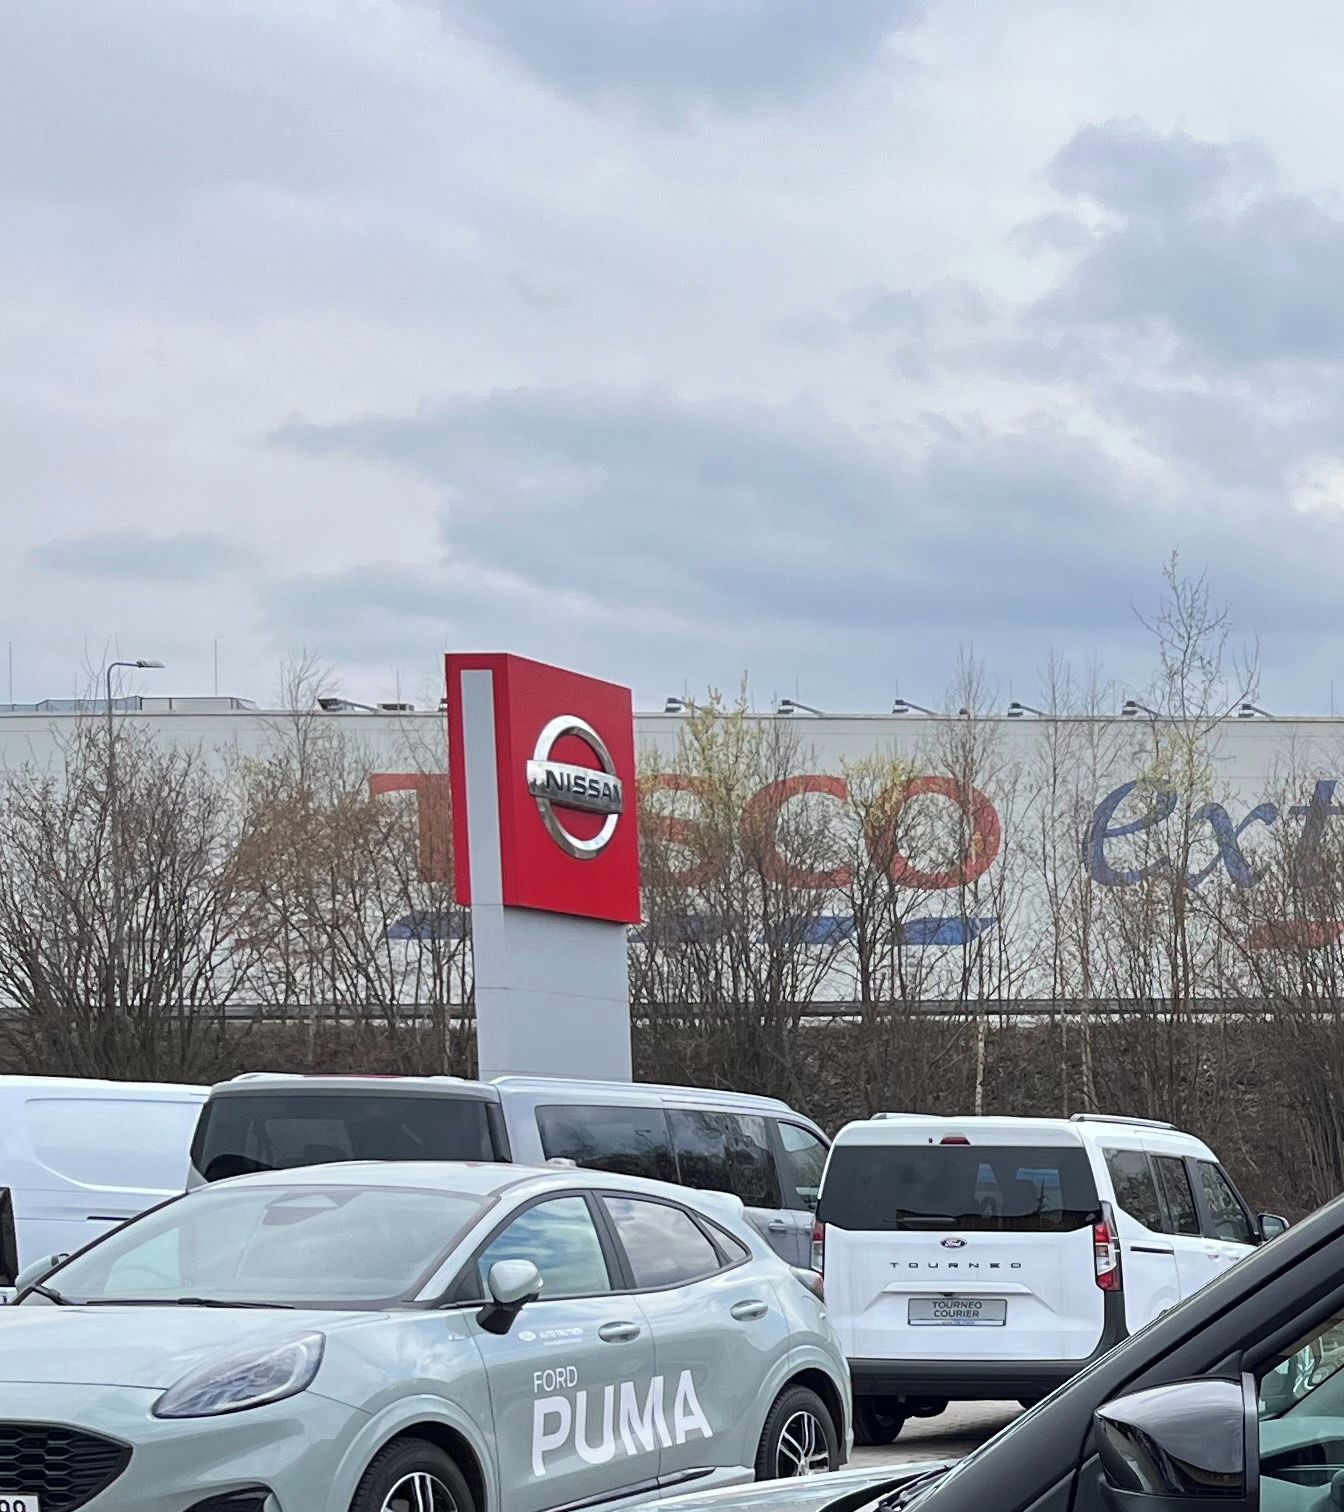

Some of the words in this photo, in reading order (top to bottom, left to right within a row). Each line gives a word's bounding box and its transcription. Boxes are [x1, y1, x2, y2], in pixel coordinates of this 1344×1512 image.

[545, 769, 621, 803] NISSAN
[368, 772, 1001, 890] TSCO
[932, 1301, 983, 1309] TOURNEO
[933, 1309, 980, 1318] COURIER
[533, 1366, 578, 1393] FORD
[531, 1369, 714, 1477] PUMA
